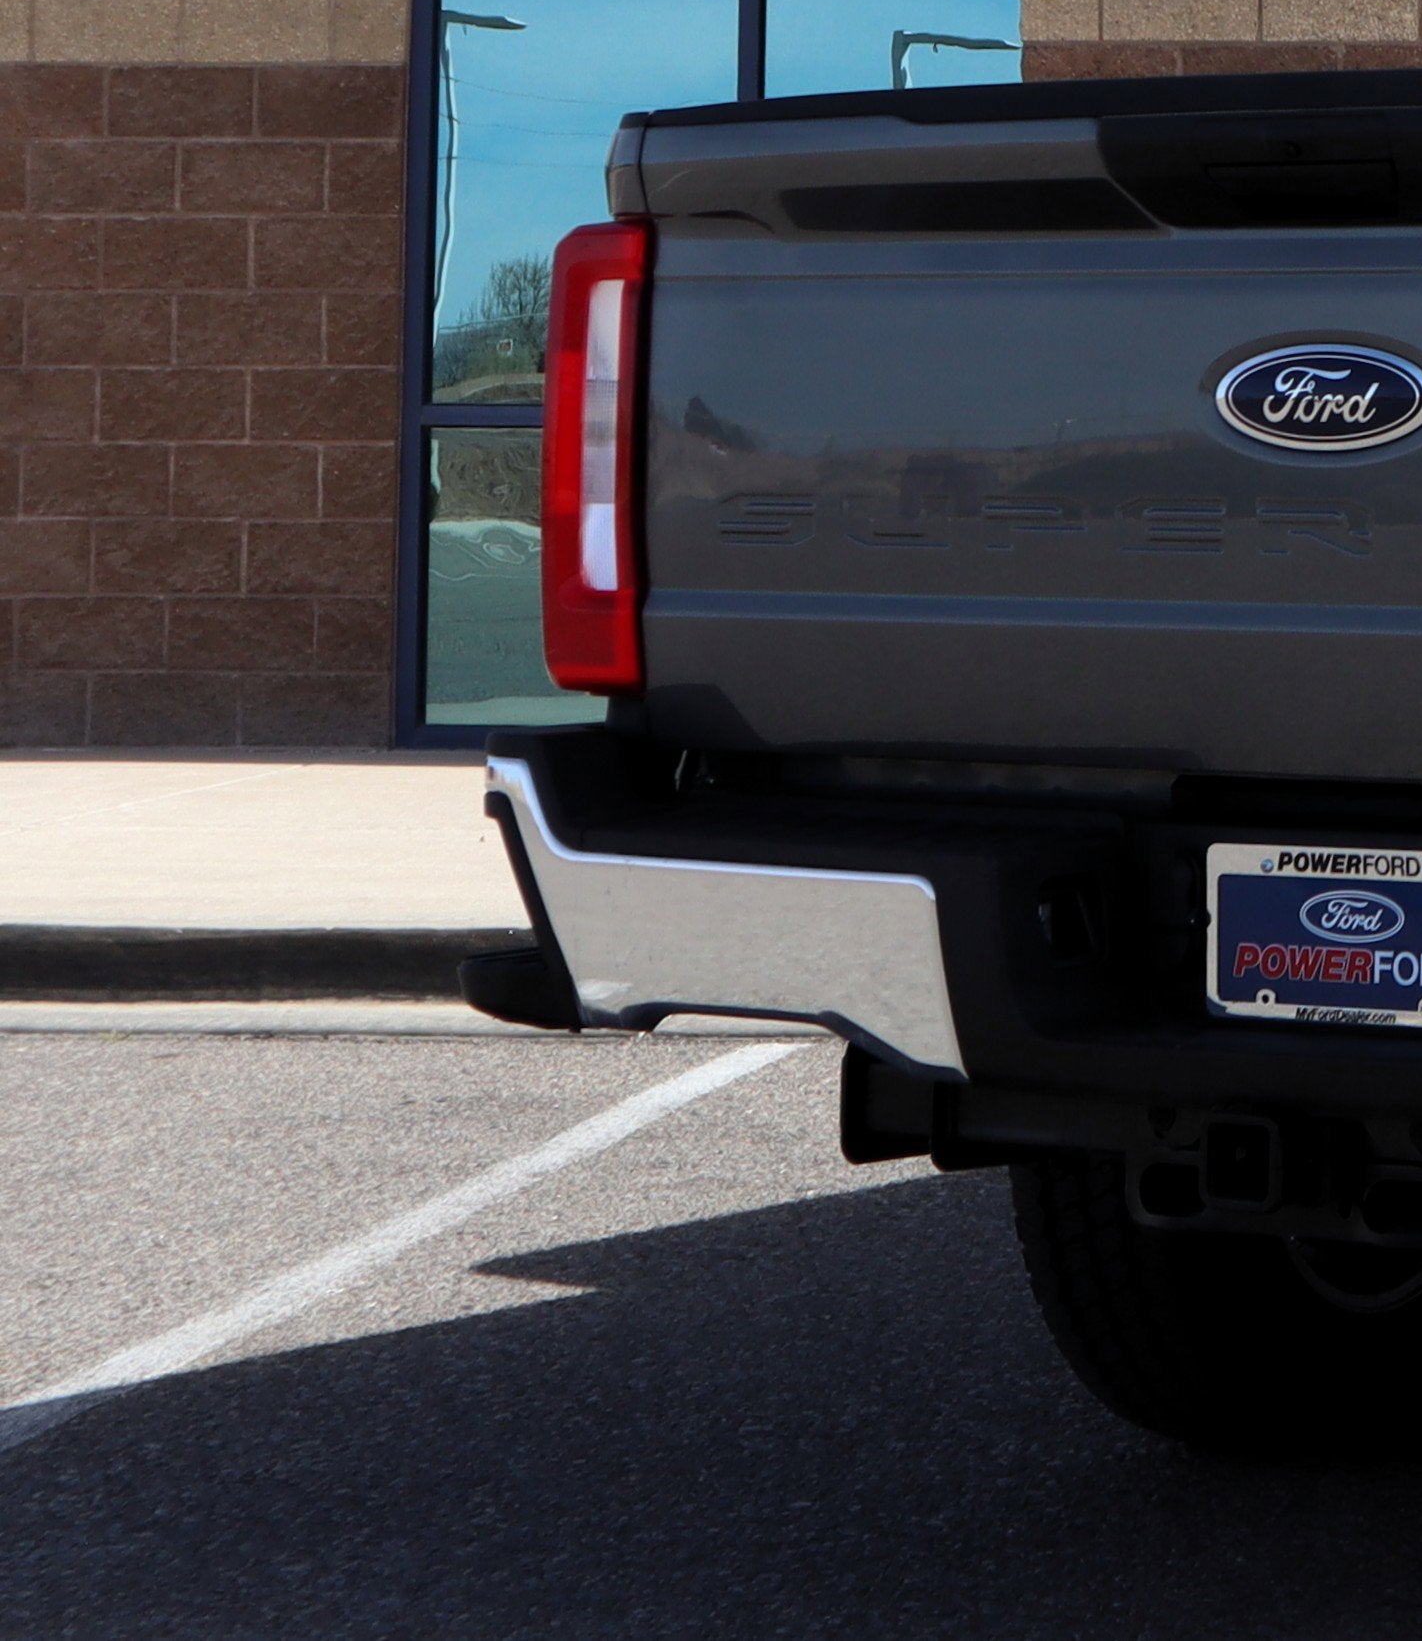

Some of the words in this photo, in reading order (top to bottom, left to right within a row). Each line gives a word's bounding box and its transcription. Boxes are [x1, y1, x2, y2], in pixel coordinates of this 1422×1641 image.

[1262, 366, 1381, 423] Ford
[717, 491, 1372, 556] SUPER
[1276, 851, 1422, 878] POWERFORD
[1321, 898, 1384, 932] Ford
